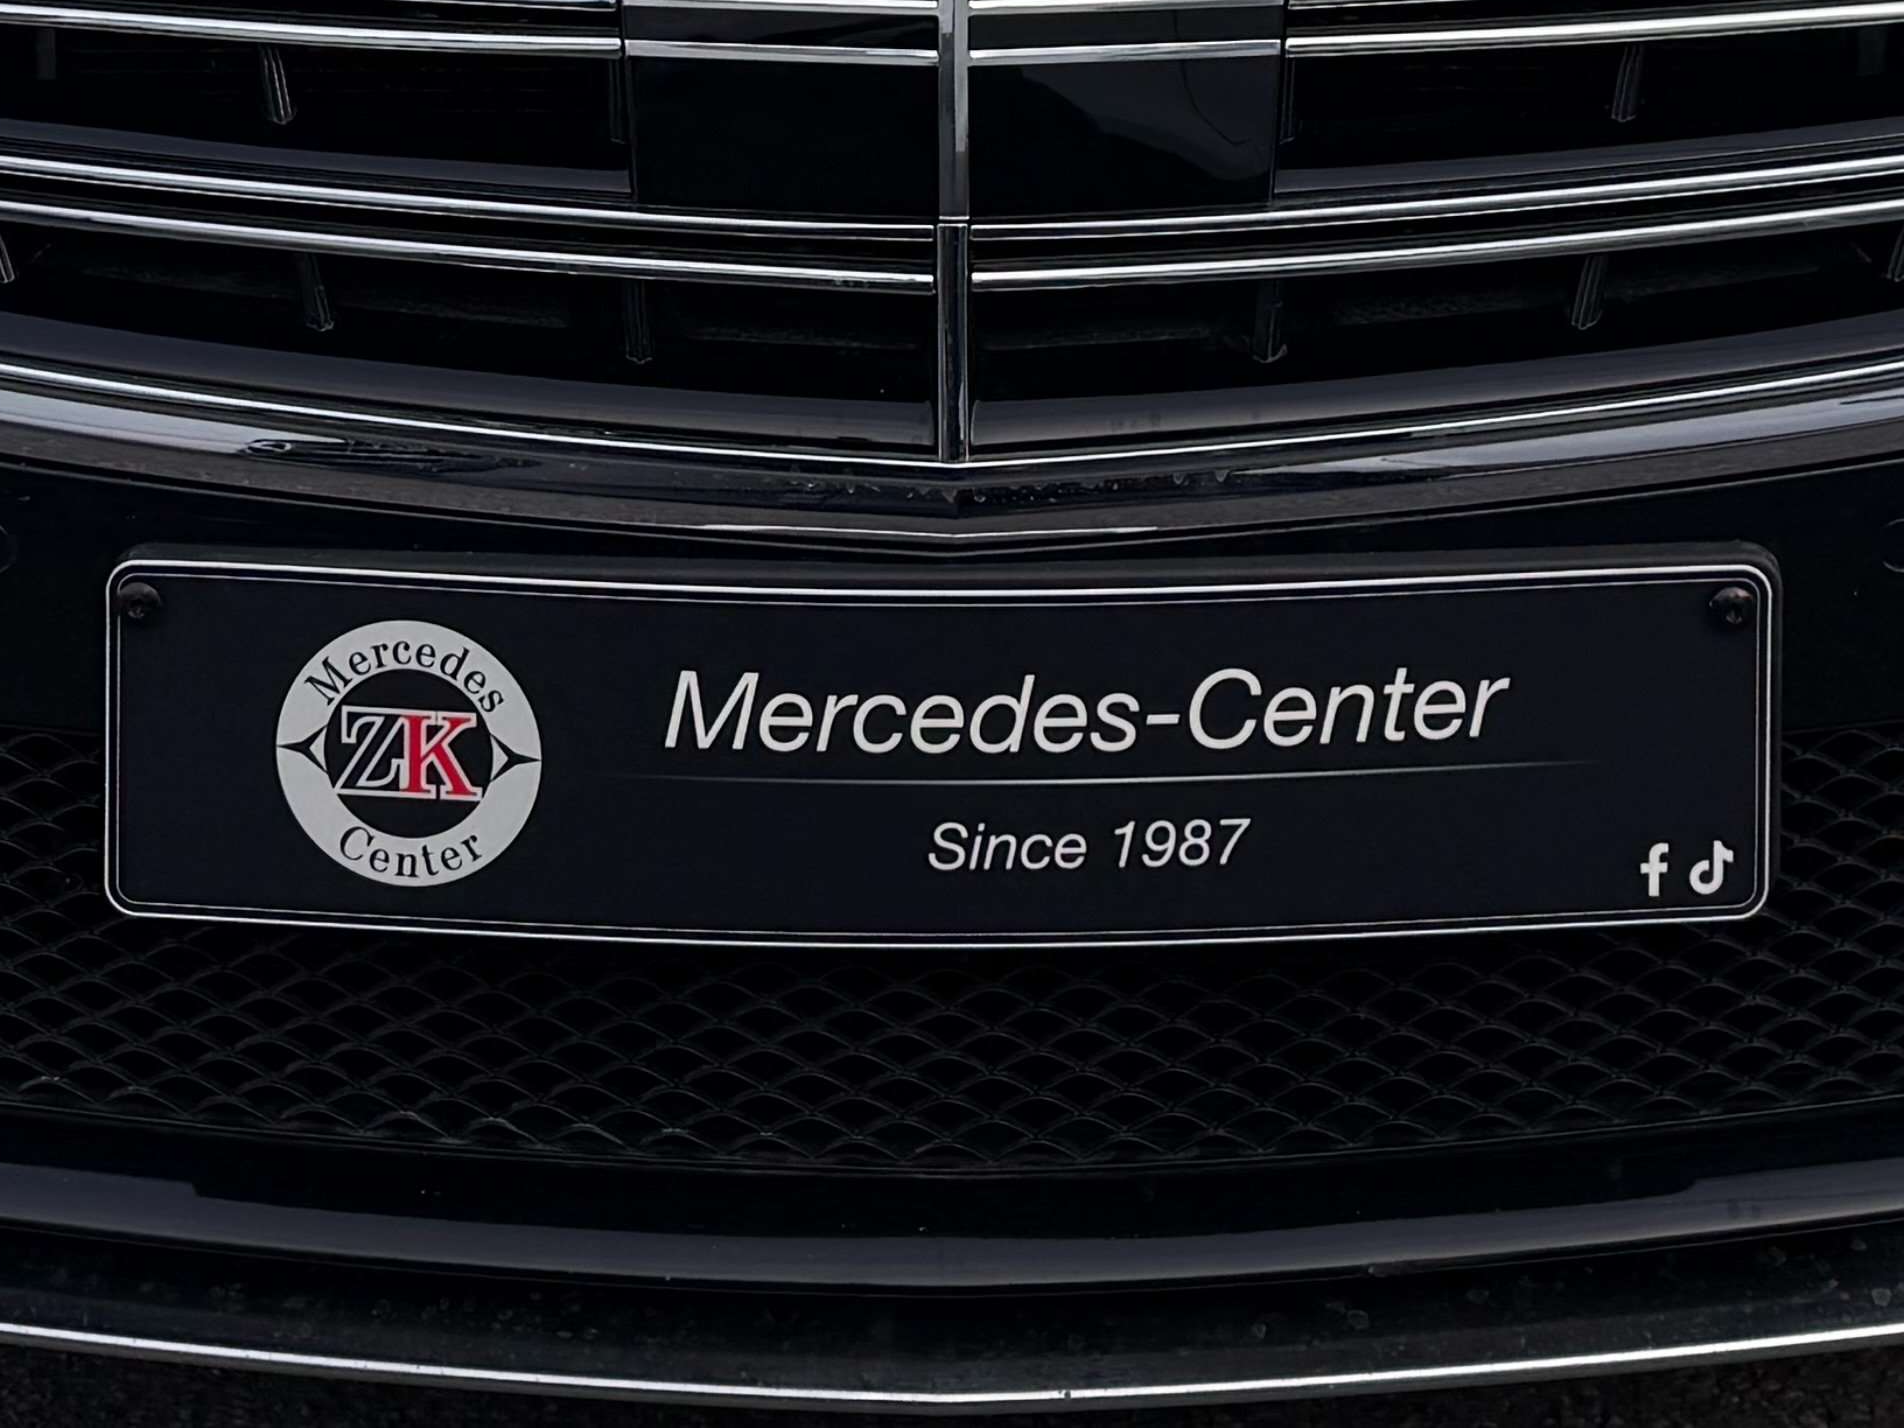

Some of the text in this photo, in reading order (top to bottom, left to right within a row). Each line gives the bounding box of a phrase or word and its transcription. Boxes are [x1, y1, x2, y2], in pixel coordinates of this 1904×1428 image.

[304, 640, 505, 713] Mercedes
[663, 666, 1512, 756] Mercedes-Center
[334, 704, 484, 802] ZK
[339, 825, 483, 878] Center
[927, 816, 1251, 873] Since 1987
